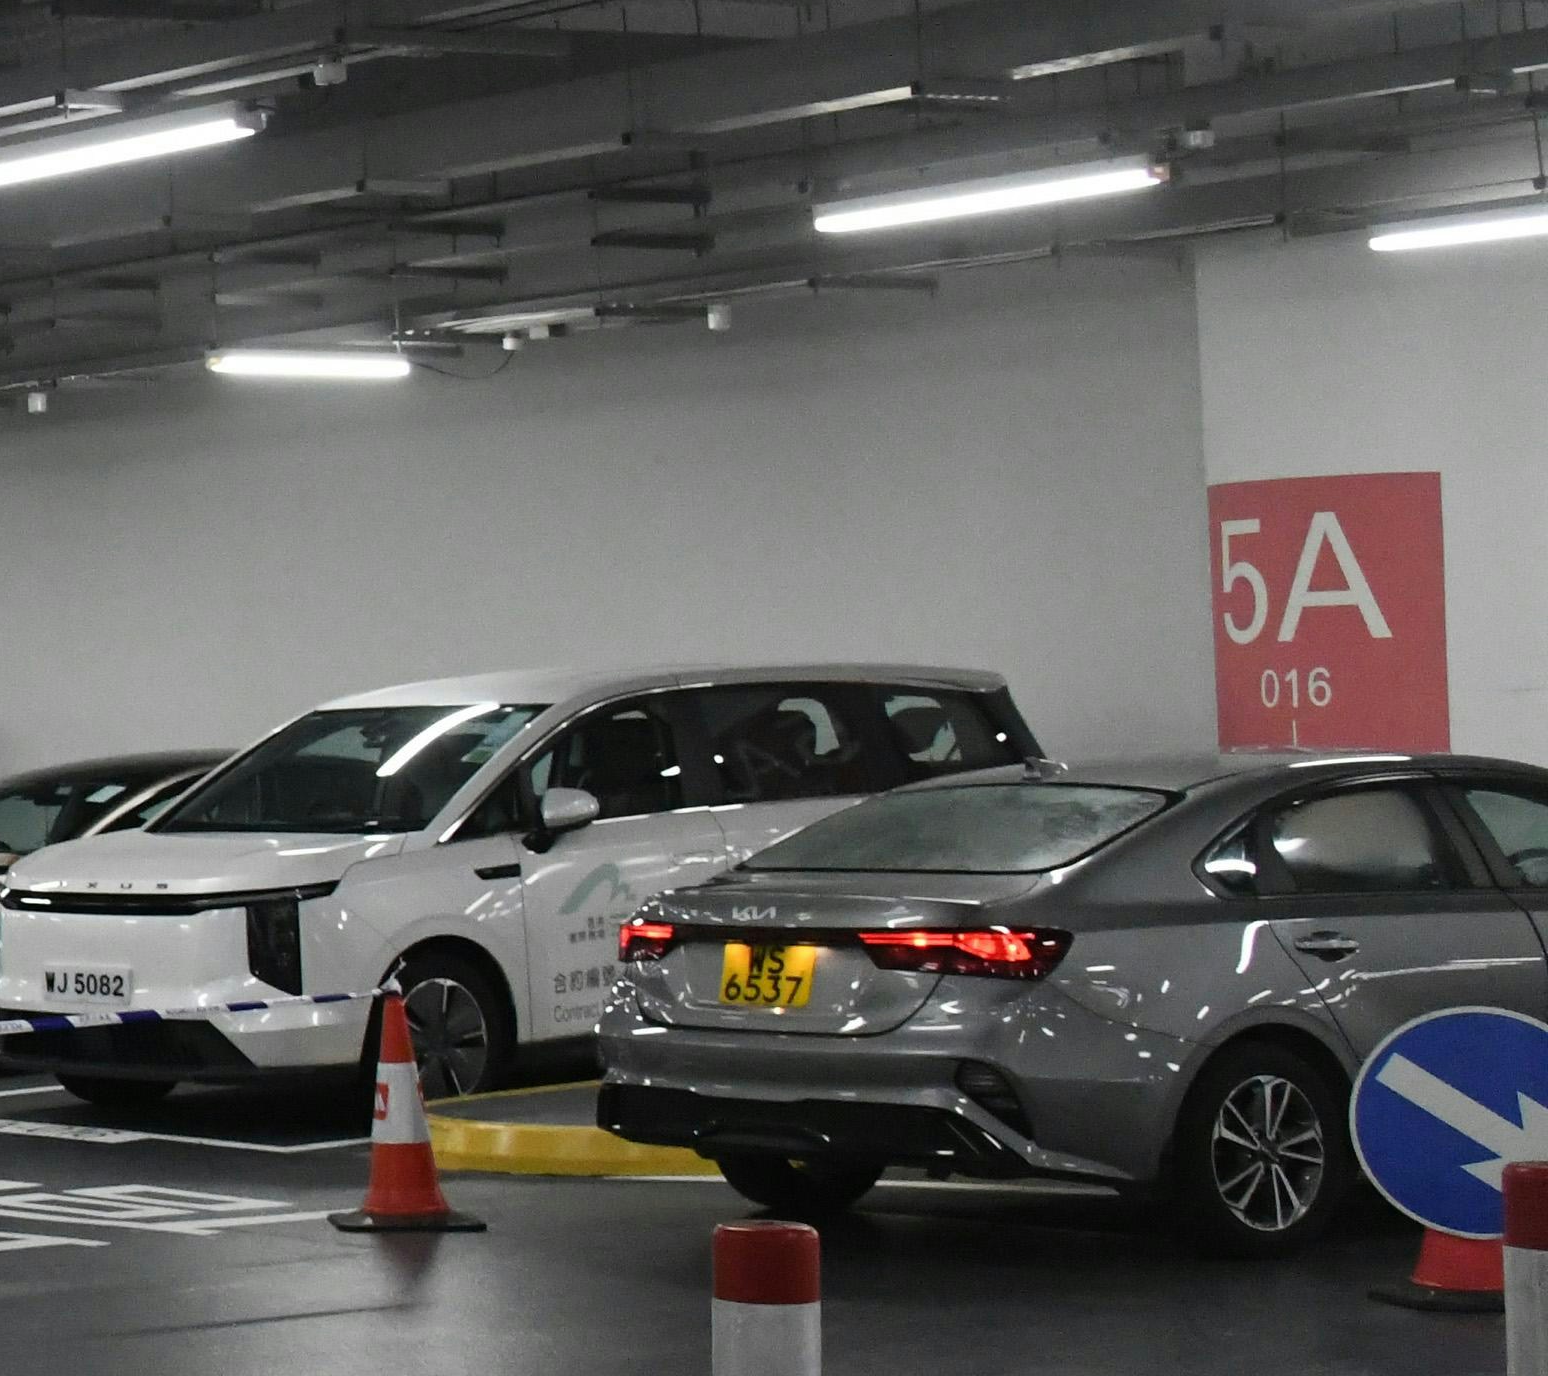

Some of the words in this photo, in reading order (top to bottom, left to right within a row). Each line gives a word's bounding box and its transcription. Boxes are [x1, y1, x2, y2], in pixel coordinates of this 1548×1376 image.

[1220, 510, 1393, 645] 5A
[1261, 667, 1334, 708] 016
[751, 945, 785, 975] WS
[44, 971, 68, 994] WJ
[74, 972, 125, 997] 5082
[724, 973, 803, 1004] 6537
